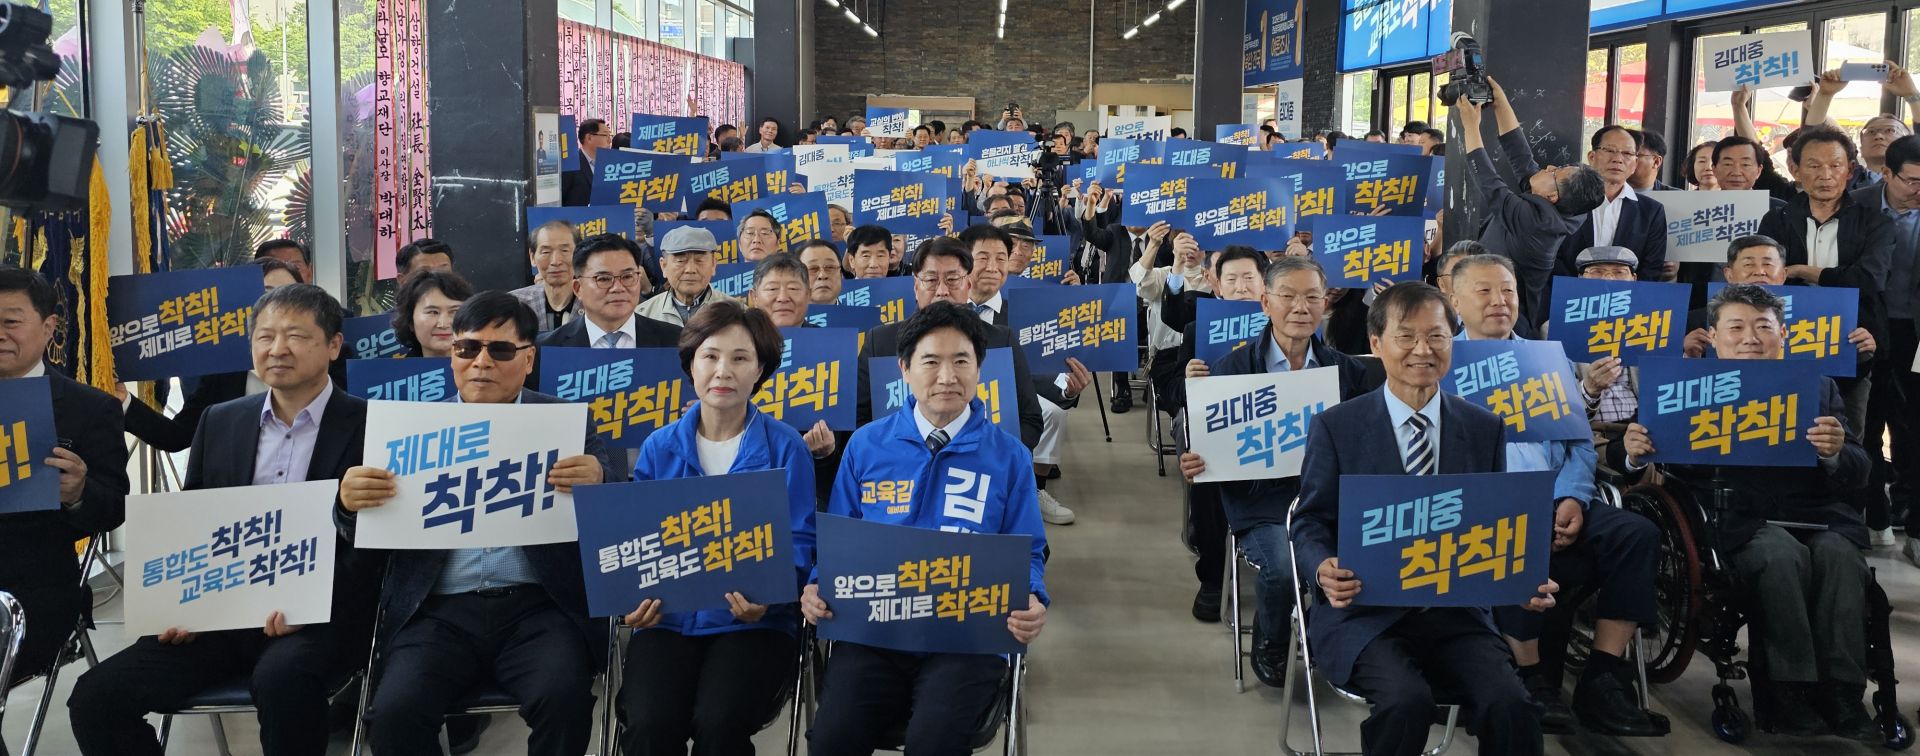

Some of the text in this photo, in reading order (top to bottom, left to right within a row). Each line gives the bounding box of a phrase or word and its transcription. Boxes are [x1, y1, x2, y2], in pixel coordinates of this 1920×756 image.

[1714, 40, 1764, 69] 김대중
[1734, 50, 1798, 85] 착착!
[638, 121, 677, 141] 제대로
[1115, 121, 1144, 136] 앞으로
[380, 147, 391, 182] 이사장
[604, 160, 653, 182] 앞으로
[799, 149, 824, 166] 김대중
[1104, 145, 1140, 165] 김대중
[1171, 148, 1211, 166] 김대중
[620, 173, 679, 208] 착착!
[690, 166, 730, 194] 김대중
[1130, 188, 1160, 206] 앞으로
[1355, 175, 1418, 209] 착착!
[379, 190, 396, 239] 박대하
[861, 194, 891, 213] 앞으로
[891, 183, 924, 204] 착착!
[876, 205, 907, 221] 제대로
[908, 198, 940, 218] 착착!
[1145, 198, 1177, 216] 제대로
[1194, 191, 1268, 228] 앞으로 착착!
[1213, 206, 1287, 238] 제대로 착착!
[1668, 203, 1736, 235] 으로 착착!
[1324, 223, 1377, 255] 앞으로
[1676, 228, 1714, 247] 제대로
[1031, 259, 1062, 281] 착착!
[1343, 239, 1412, 283] 착착!
[839, 286, 871, 308] 대중
[1564, 289, 1633, 324] 김대중
[109, 286, 219, 347] 앞으로 착착!
[1018, 299, 1103, 346] 통합도 착착!
[1208, 312, 1271, 345] 김대중
[1587, 310, 1673, 358] 착착!
[138, 325, 194, 361] 제대로
[356, 329, 403, 359] 앞으
[1041, 317, 1126, 357] 교육도 착착!
[1782, 315, 1842, 359] 착!
[368, 368, 447, 402] 김대중
[557, 358, 635, 401] 김대중
[1454, 350, 1521, 397] 김대중
[589, 378, 682, 440] 착착!
[1205, 384, 1278, 433] 김대중
[1487, 371, 1571, 433] 착착!
[1657, 369, 1742, 416] 김대중
[1689, 393, 1799, 456] 착착!
[386, 419, 492, 477] 제대로
[422, 448, 560, 535] 착착!
[861, 479, 915, 504] 교육감
[943, 466, 991, 524] 김
[1361, 488, 1464, 547] 김대중
[142, 508, 283, 588] 통합도 착착!
[598, 497, 733, 574] 통합도 착착!
[179, 536, 318, 605] 교육도 착착!
[637, 522, 774, 590] 교육도 착착!
[1400, 513, 1529, 595] 착착!
[834, 554, 971, 599] 앞으로 착착!
[868, 583, 1010, 623] 제대로 착착!
